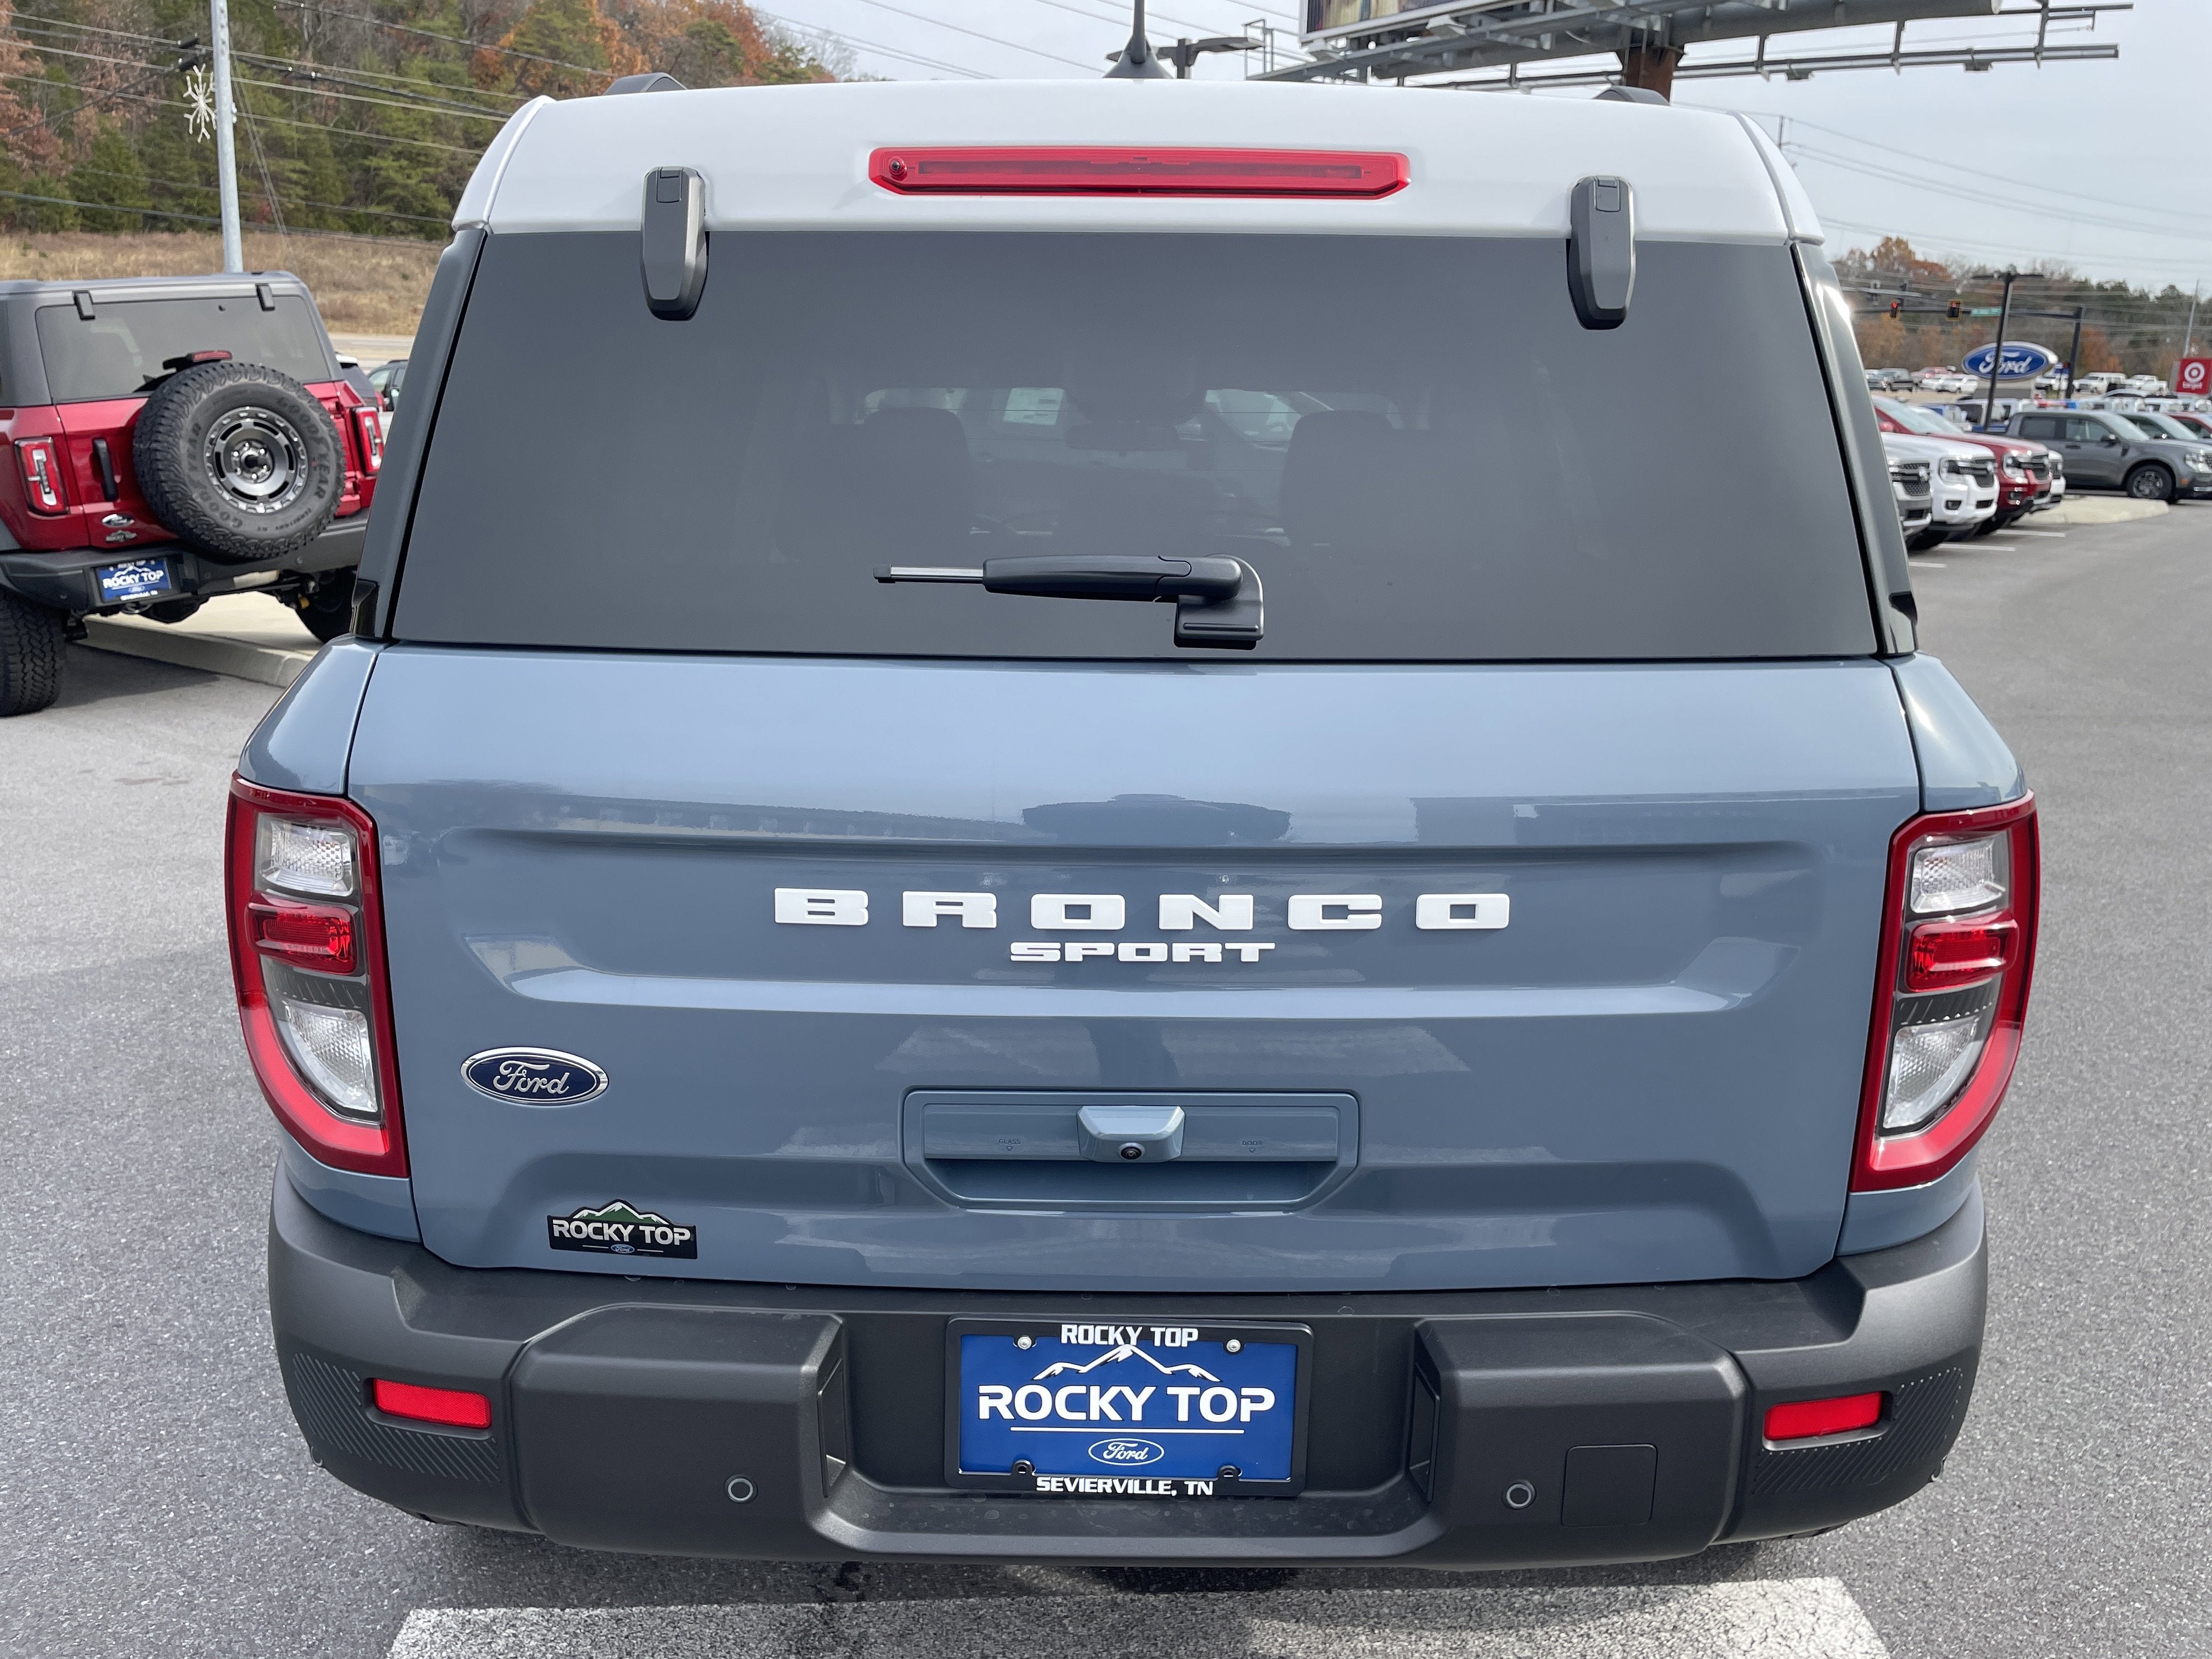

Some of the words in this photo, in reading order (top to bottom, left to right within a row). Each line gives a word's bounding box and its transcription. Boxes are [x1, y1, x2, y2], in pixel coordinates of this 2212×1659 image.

[1978, 351, 2033, 374] Ford
[103, 573, 139, 589] ROCKY
[140, 569, 164, 582] TOP
[774, 887, 1511, 930] BRONCO
[1010, 942, 1276, 963] SPORT
[492, 1059, 570, 1095] Ford
[552, 1219, 635, 1242] ROCKY
[639, 1225, 691, 1245] TOP
[1060, 1324, 1143, 1347] ROCKY
[1150, 1326, 1199, 1348] TOP
[978, 1384, 1157, 1421] ROCKY
[1166, 1386, 1276, 1423] TOP
[1102, 1442, 1149, 1462] Ford
[1036, 1477, 1177, 1496] SEVIERVILLE,
[1183, 1480, 1214, 1496] TN
